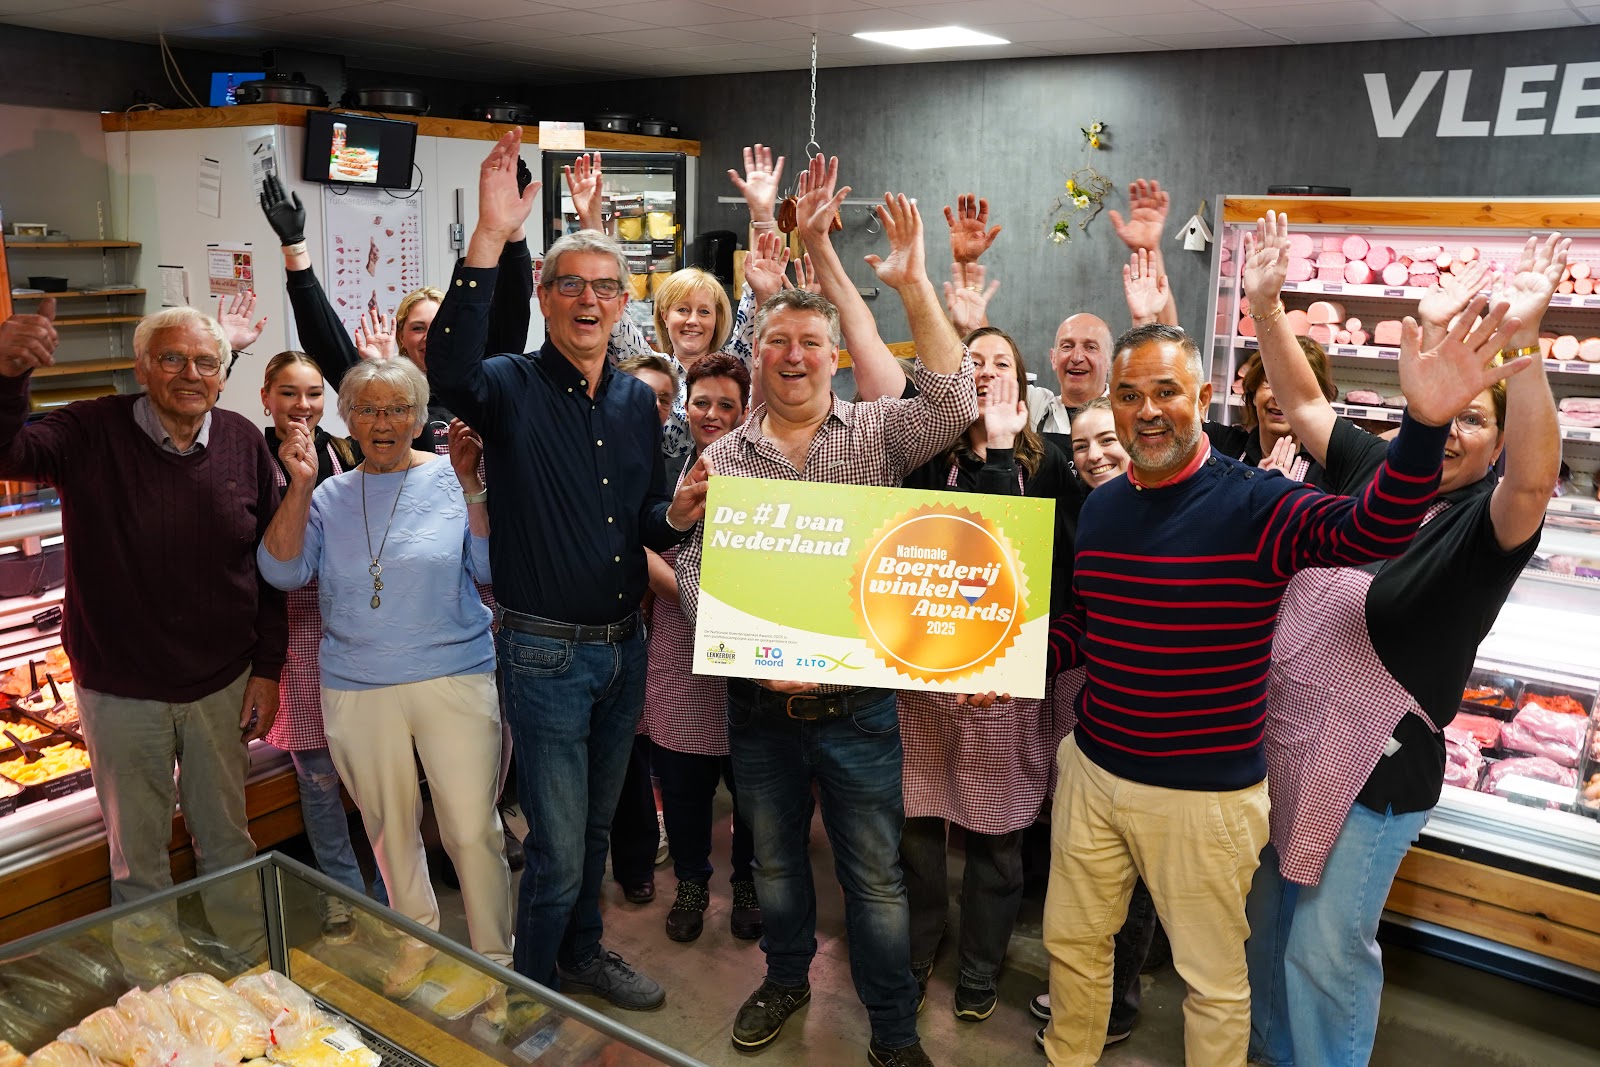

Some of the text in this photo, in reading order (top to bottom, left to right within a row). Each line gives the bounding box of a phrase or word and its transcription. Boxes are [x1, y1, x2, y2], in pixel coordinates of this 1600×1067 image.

[1363, 61, 1600, 138] VLEE
[712, 503, 844, 532] De #1 van
[710, 529, 851, 556] Nederland
[896, 544, 948, 560] Nationale
[876, 556, 1001, 586] Boerderij
[869, 576, 960, 599] winkel
[910, 598, 1012, 622] Awards
[926, 620, 956, 636] 2025
[754, 659, 784, 667] noord
[755, 646, 783, 659] LTO
[796, 658, 826, 668] ZLTO
